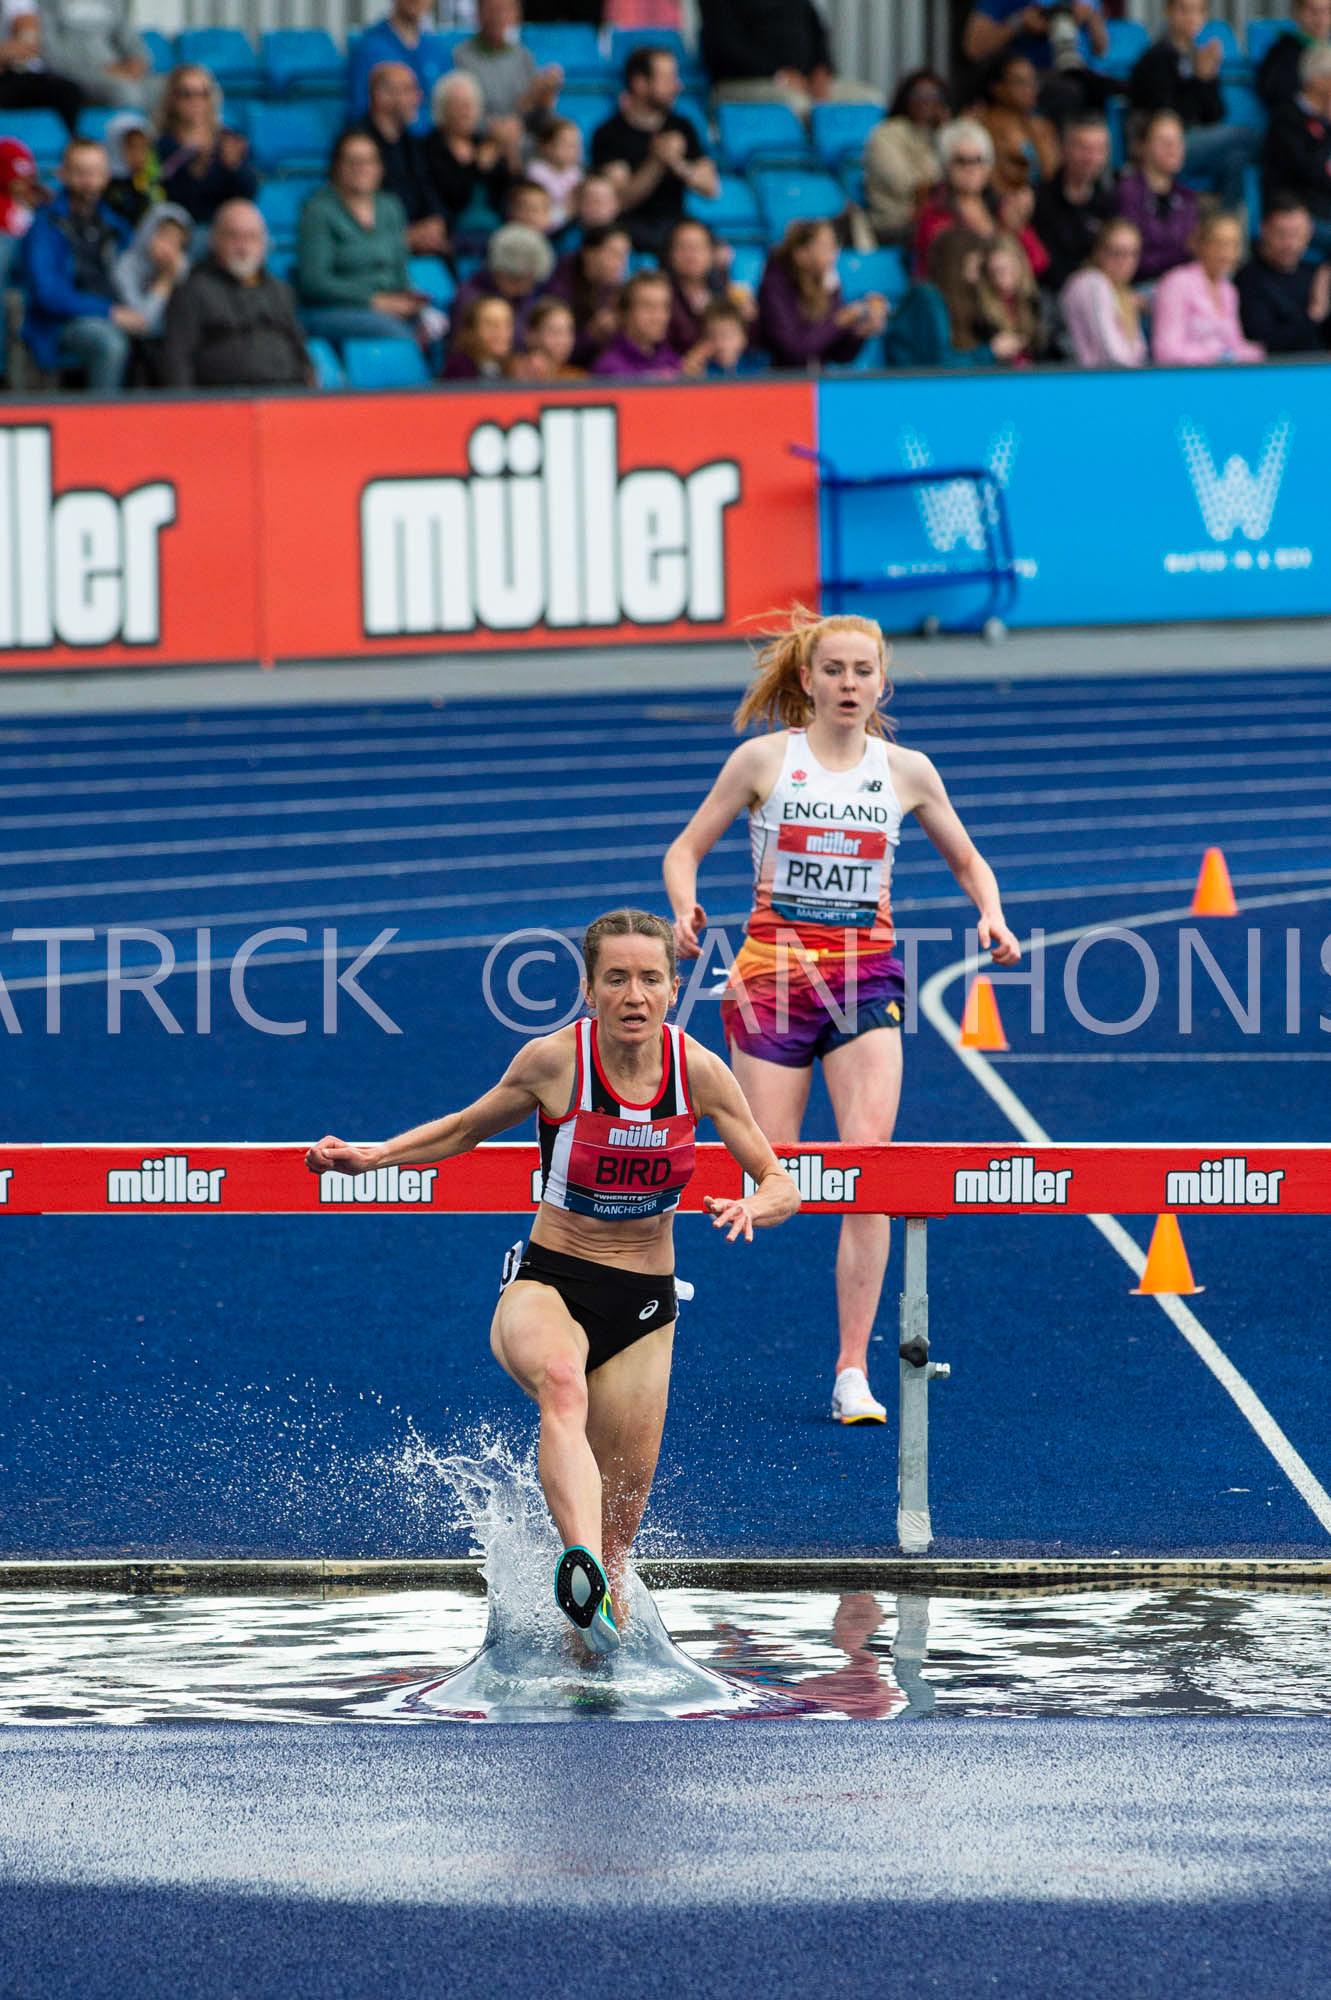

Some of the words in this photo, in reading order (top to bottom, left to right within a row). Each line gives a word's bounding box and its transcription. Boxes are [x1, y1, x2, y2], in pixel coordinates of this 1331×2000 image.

[360, 405, 741, 638] müller
[783, 802, 888, 824] ENGLAND
[806, 831, 862, 856] müller
[786, 860, 873, 893] PRATT
[797, 908, 857, 920] MANCHESTER
[608, 1125, 670, 1147] müller
[107, 1156, 227, 1204] müller
[595, 1156, 671, 1186] BIRD
[954, 1156, 1074, 1204] müller
[1165, 1157, 1286, 1204] müller
[594, 1200, 657, 1214] MANCHESTER
